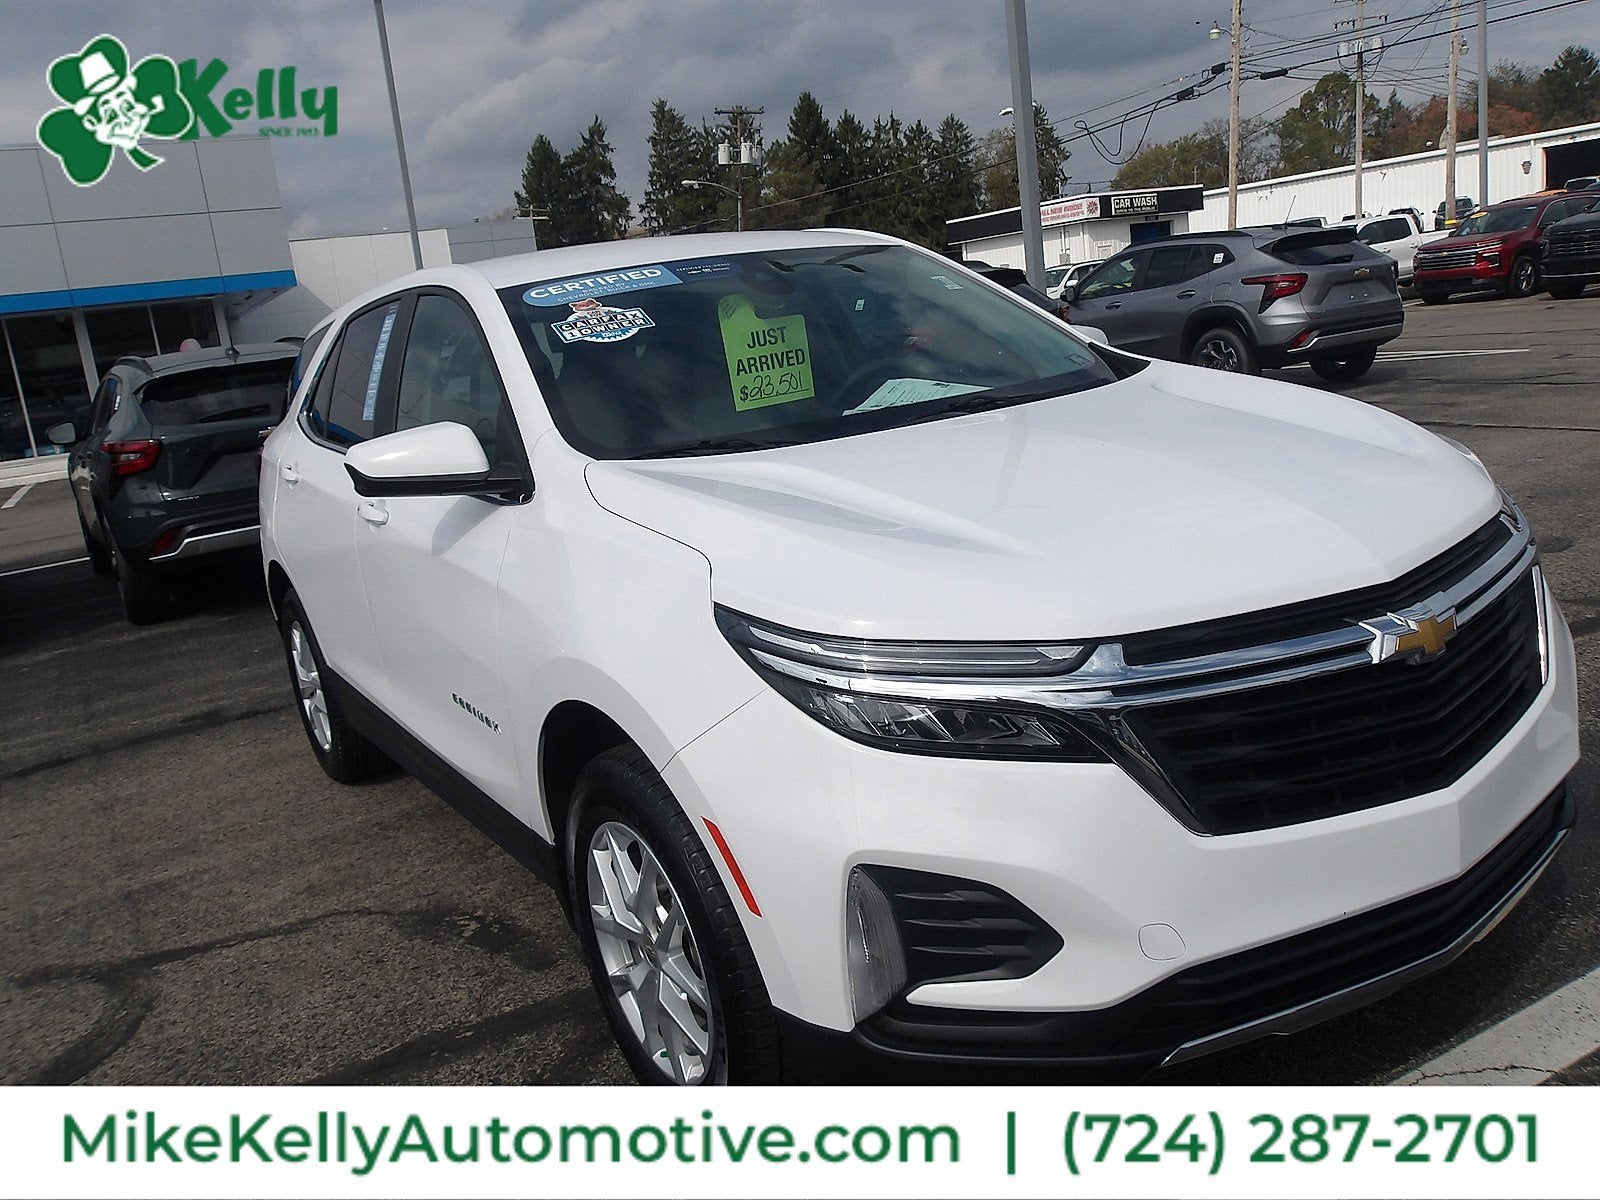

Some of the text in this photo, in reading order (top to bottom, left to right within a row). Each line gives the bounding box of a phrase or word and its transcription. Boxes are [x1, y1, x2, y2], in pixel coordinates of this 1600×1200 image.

[1114, 196, 1157, 209] CAR WASH
[530, 267, 662, 298] CERTIFIED
[561, 312, 640, 331] CARFAX
[580, 319, 646, 335] OWNER
[746, 326, 787, 349] JUST
[736, 348, 806, 376] ARRIVED
[452, 693, 500, 735] EQUINOX
